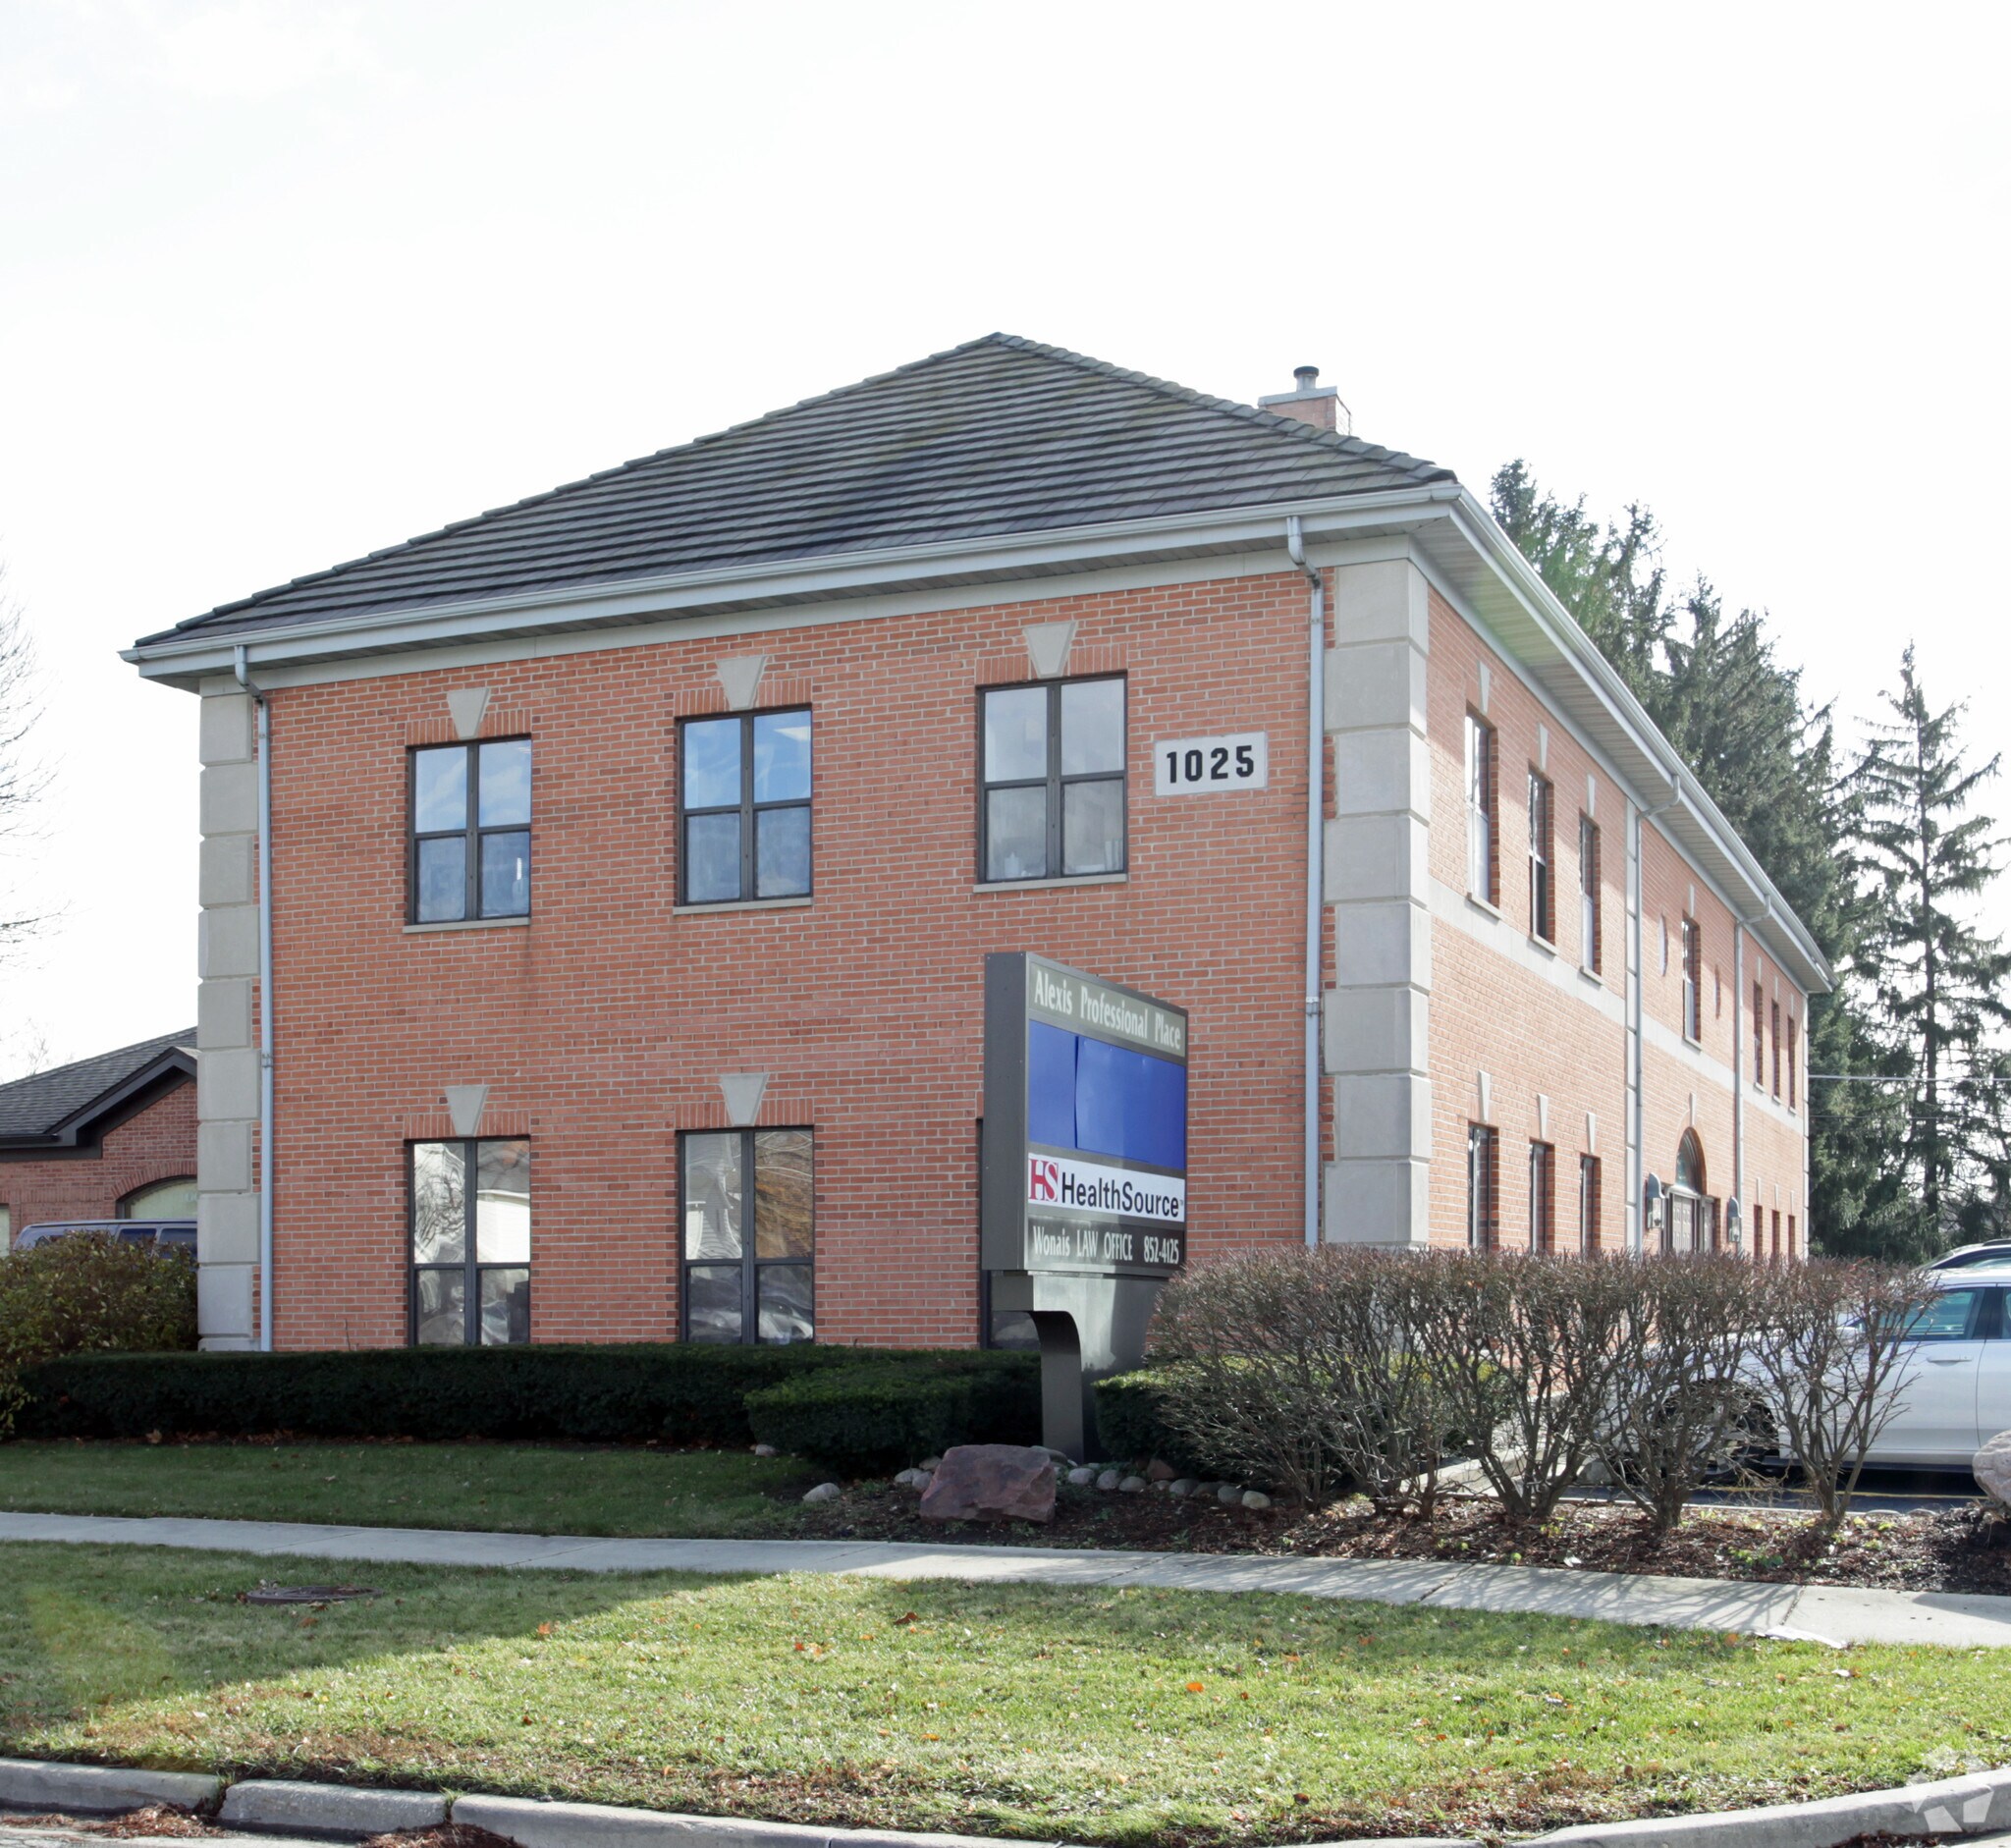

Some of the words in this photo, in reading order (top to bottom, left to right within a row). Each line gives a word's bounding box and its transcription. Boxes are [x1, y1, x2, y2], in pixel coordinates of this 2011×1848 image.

[1167, 744, 1255, 784] 1025
[1034, 969, 1073, 1015] Alexis
[1080, 985, 1149, 1039] Professional
[1154, 1011, 1181, 1050] Place
[1028, 1158, 1060, 1203] HS
[1061, 1171, 1179, 1218] HealthSource
[1033, 1225, 1071, 1257] Wonais
[1076, 1229, 1099, 1258] LAW
[1103, 1231, 1133, 1262] OFFICE
[1143, 1235, 1180, 1265] 852-4125
